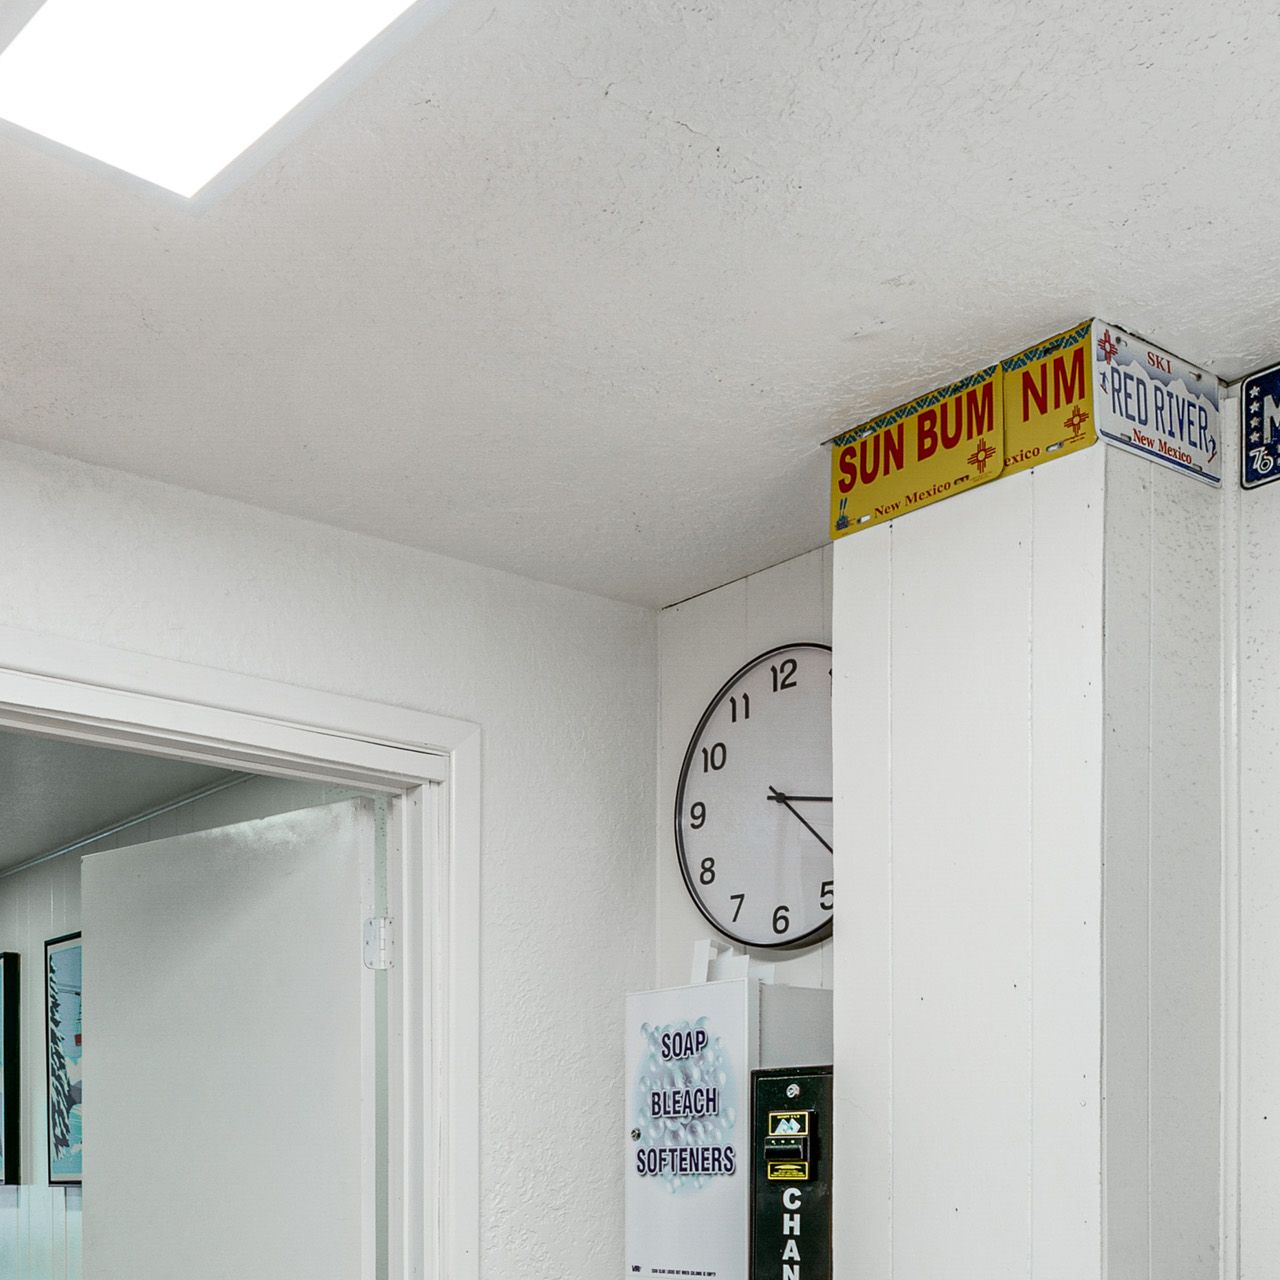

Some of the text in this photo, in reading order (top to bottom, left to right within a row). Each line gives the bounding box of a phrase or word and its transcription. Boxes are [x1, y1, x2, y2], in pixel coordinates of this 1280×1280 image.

[1147, 351, 1173, 375] SKI
[1022, 346, 1085, 423] NM
[1110, 366, 1209, 453] RED RIVER
[837, 381, 994, 494] SUN BUM
[1132, 428, 1192, 465] New Mexico
[1004, 447, 1040, 467] exico
[874, 482, 951, 519] New Mexico
[770, 658, 798, 692] 12
[729, 692, 750, 723] 11
[702, 742, 727, 773] 10
[690, 801, 706, 829] 9
[699, 857, 716, 885] 8
[730, 893, 745, 922] 7
[820, 880, 833, 911] 5
[772, 905, 790, 934] 6
[661, 1029, 708, 1060] SOAP
[651, 1087, 719, 1117] BLEACH
[636, 1145, 736, 1175] SOFTENERS
